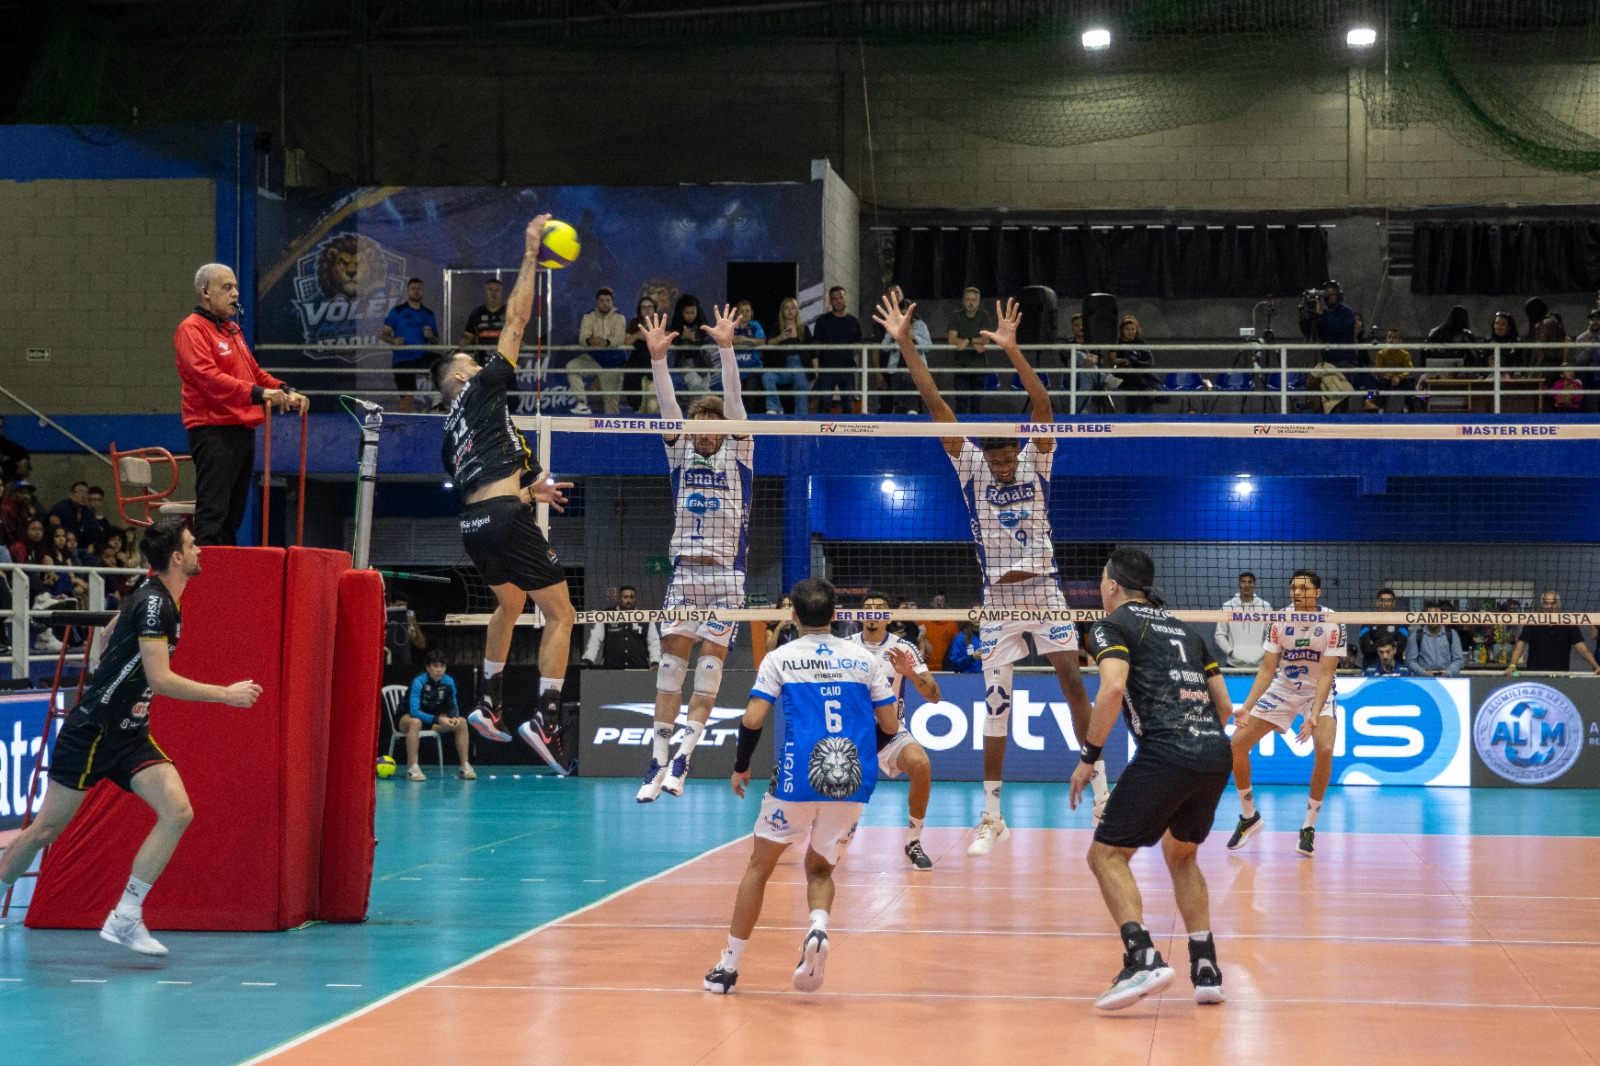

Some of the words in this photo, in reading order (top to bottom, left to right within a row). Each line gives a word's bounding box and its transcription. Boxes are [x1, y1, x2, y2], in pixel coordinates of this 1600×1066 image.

[594, 419, 646, 430] MASTER
[650, 421, 683, 430] REDE
[1020, 424, 1074, 433] MASTER
[1077, 425, 1112, 433] REDE
[1462, 426, 1519, 435] MASTER
[1521, 426, 1558, 435] REDE
[685, 472, 728, 488] enata
[1015, 529, 1027, 547] 9
[147, 595, 159, 618] HSM
[576, 610, 645, 622] PEONATO
[649, 610, 718, 622] PAULISTA
[857, 611, 890, 620] REDE
[967, 609, 1071, 621] CAMPEONATO
[1232, 612, 1287, 622] MASTER
[1291, 613, 1326, 622] REDE
[1405, 612, 1513, 624] CAMPEONATO
[1517, 613, 1592, 625] PAULISTA
[1050, 624, 1073, 635] Good
[1150, 623, 1186, 636] EVERALDO
[1169, 638, 1187, 663] 7
[1285, 651, 1319, 661] enata
[782, 658, 869, 674] ALUMILIGAS
[100, 651, 142, 705] ITAQUAQUECETUB
[820, 686, 841, 697] CAIO
[1293, 682, 1303, 690] 7
[824, 699, 843, 734] 6
[593, 727, 739, 746] PEALT
[1222, 704, 1425, 758] MS
